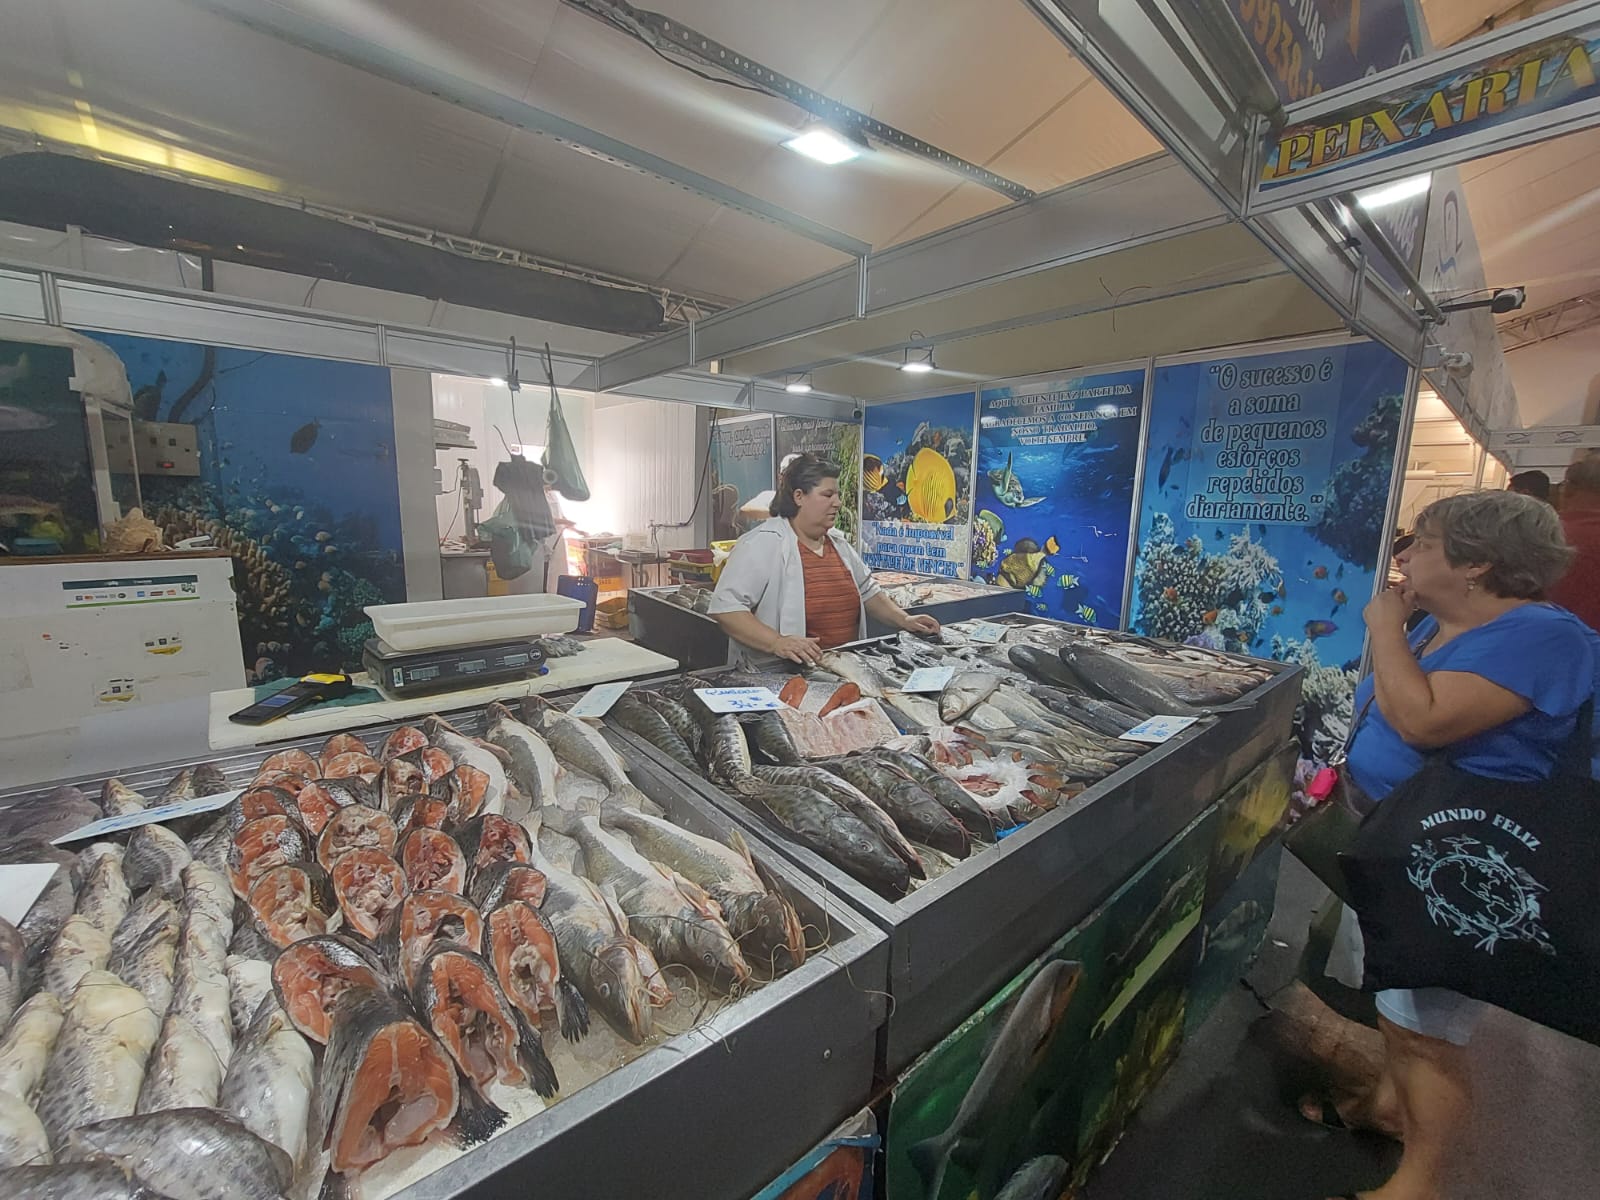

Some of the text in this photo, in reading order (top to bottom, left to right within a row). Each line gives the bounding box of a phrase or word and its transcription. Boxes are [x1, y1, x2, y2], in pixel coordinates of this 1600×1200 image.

[1273, 46, 1597, 178] PEIXARIA
[1240, 363, 1316, 387] sucesso
[1319, 356, 1333, 381] é
[989, 398, 1010, 409] AQUI
[1021, 392, 1058, 405] CLIENTE
[1059, 390, 1079, 401] FAZ
[1080, 386, 1113, 399] PARTE
[1115, 383, 1133, 395] DA
[1228, 393, 1300, 416] a soma
[983, 416, 1047, 429] AGRADECEMOS
[1120, 406, 1138, 418] EM
[1011, 425, 1041, 437] NOSSO
[1019, 436, 1047, 446] VOLTE
[1201, 418, 1327, 450] de pequenos
[1216, 443, 1301, 470] esforços
[1207, 468, 1304, 500] repetidos
[862, 552, 902, 570] VONTADE
[902, 556, 916, 572] DE
[876, 542, 946, 558] para quem tem
[1420, 808, 1541, 852] MUNDO FELIZ
